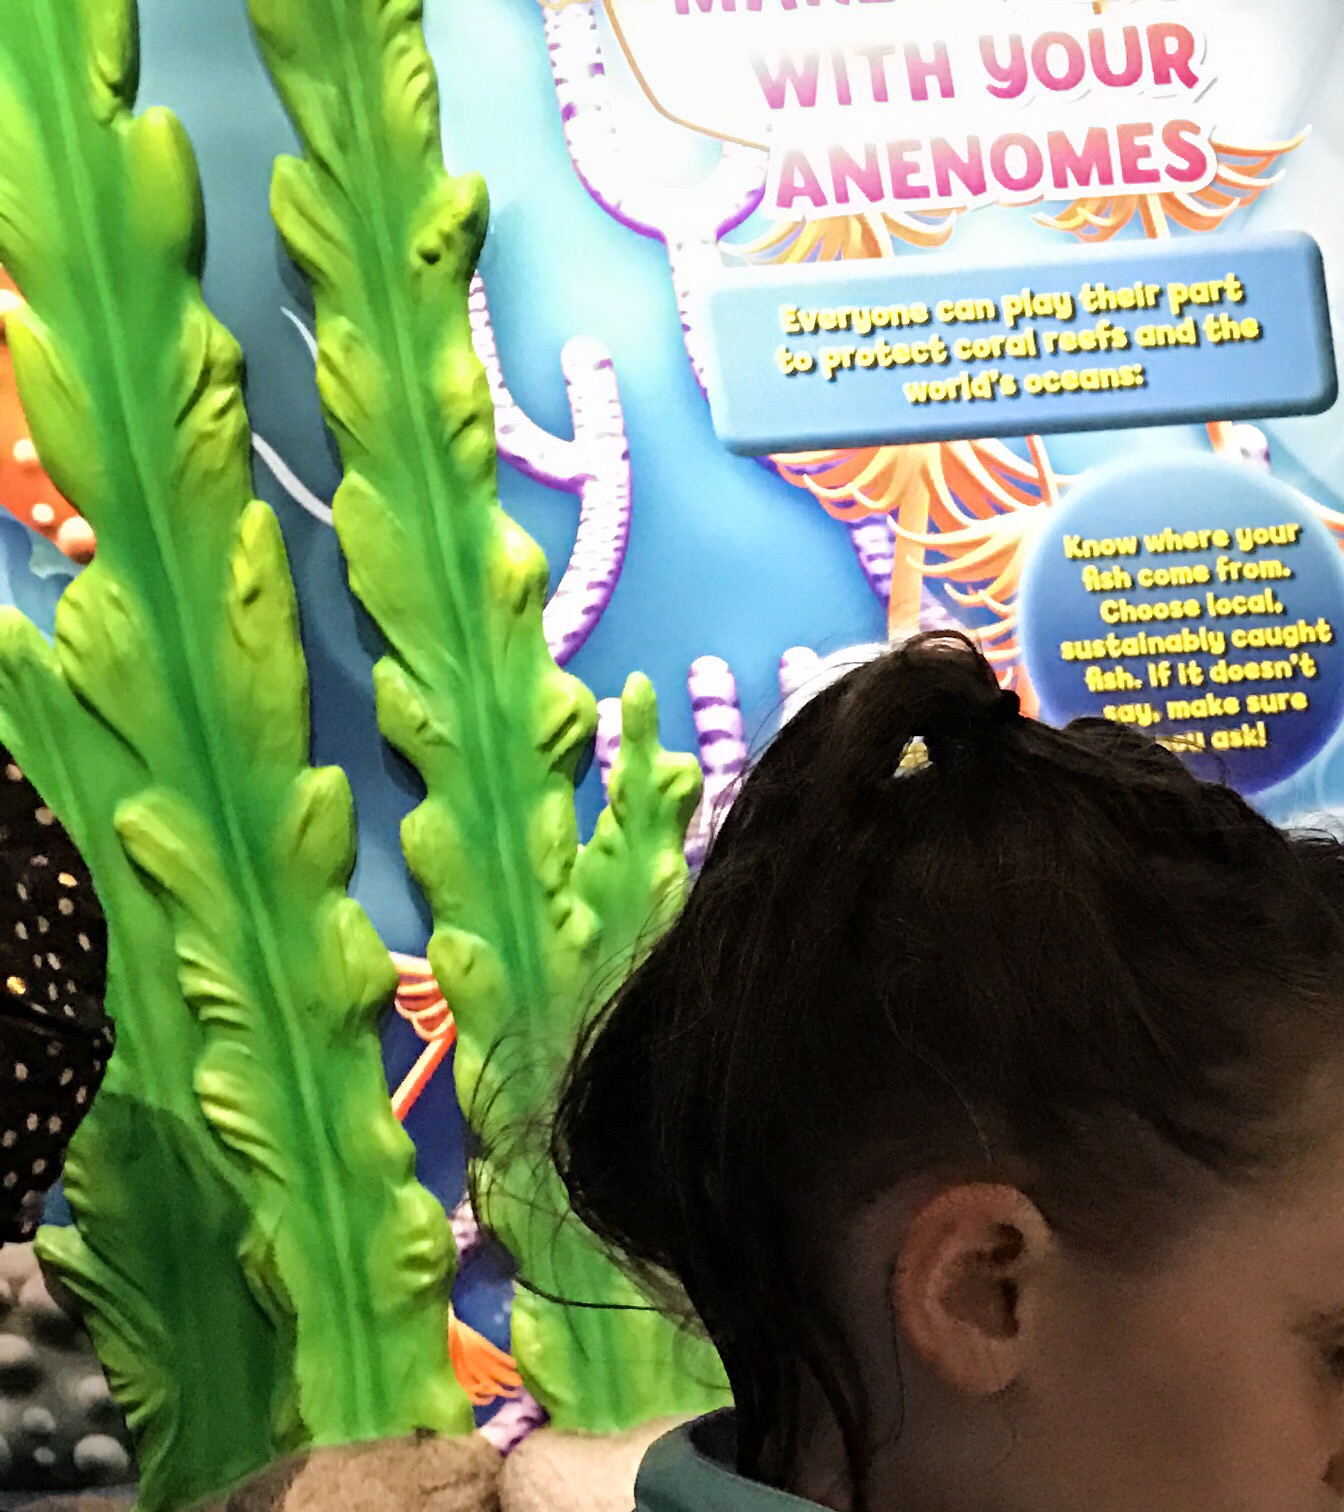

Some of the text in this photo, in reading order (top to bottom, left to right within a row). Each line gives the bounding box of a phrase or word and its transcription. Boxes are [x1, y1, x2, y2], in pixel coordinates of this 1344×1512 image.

[749, 22, 1199, 110] WITH YOUR
[776, 119, 1208, 209] ANENOMES
[779, 273, 1243, 335] Everyone can play their part
[775, 313, 1259, 379] to protect coral reefs and the
[903, 363, 1144, 403] world's oceans:
[1063, 523, 1299, 558] Know where your
[1082, 555, 1291, 591] fish come from.
[1100, 598, 1201, 624] Choose
[1060, 617, 1332, 661] sustainably caught
[1085, 652, 1317, 692] fish. If it doesn't
[1166, 693, 1240, 720] make
[1247, 691, 1308, 714] sure
[1211, 721, 1267, 750] ask!
